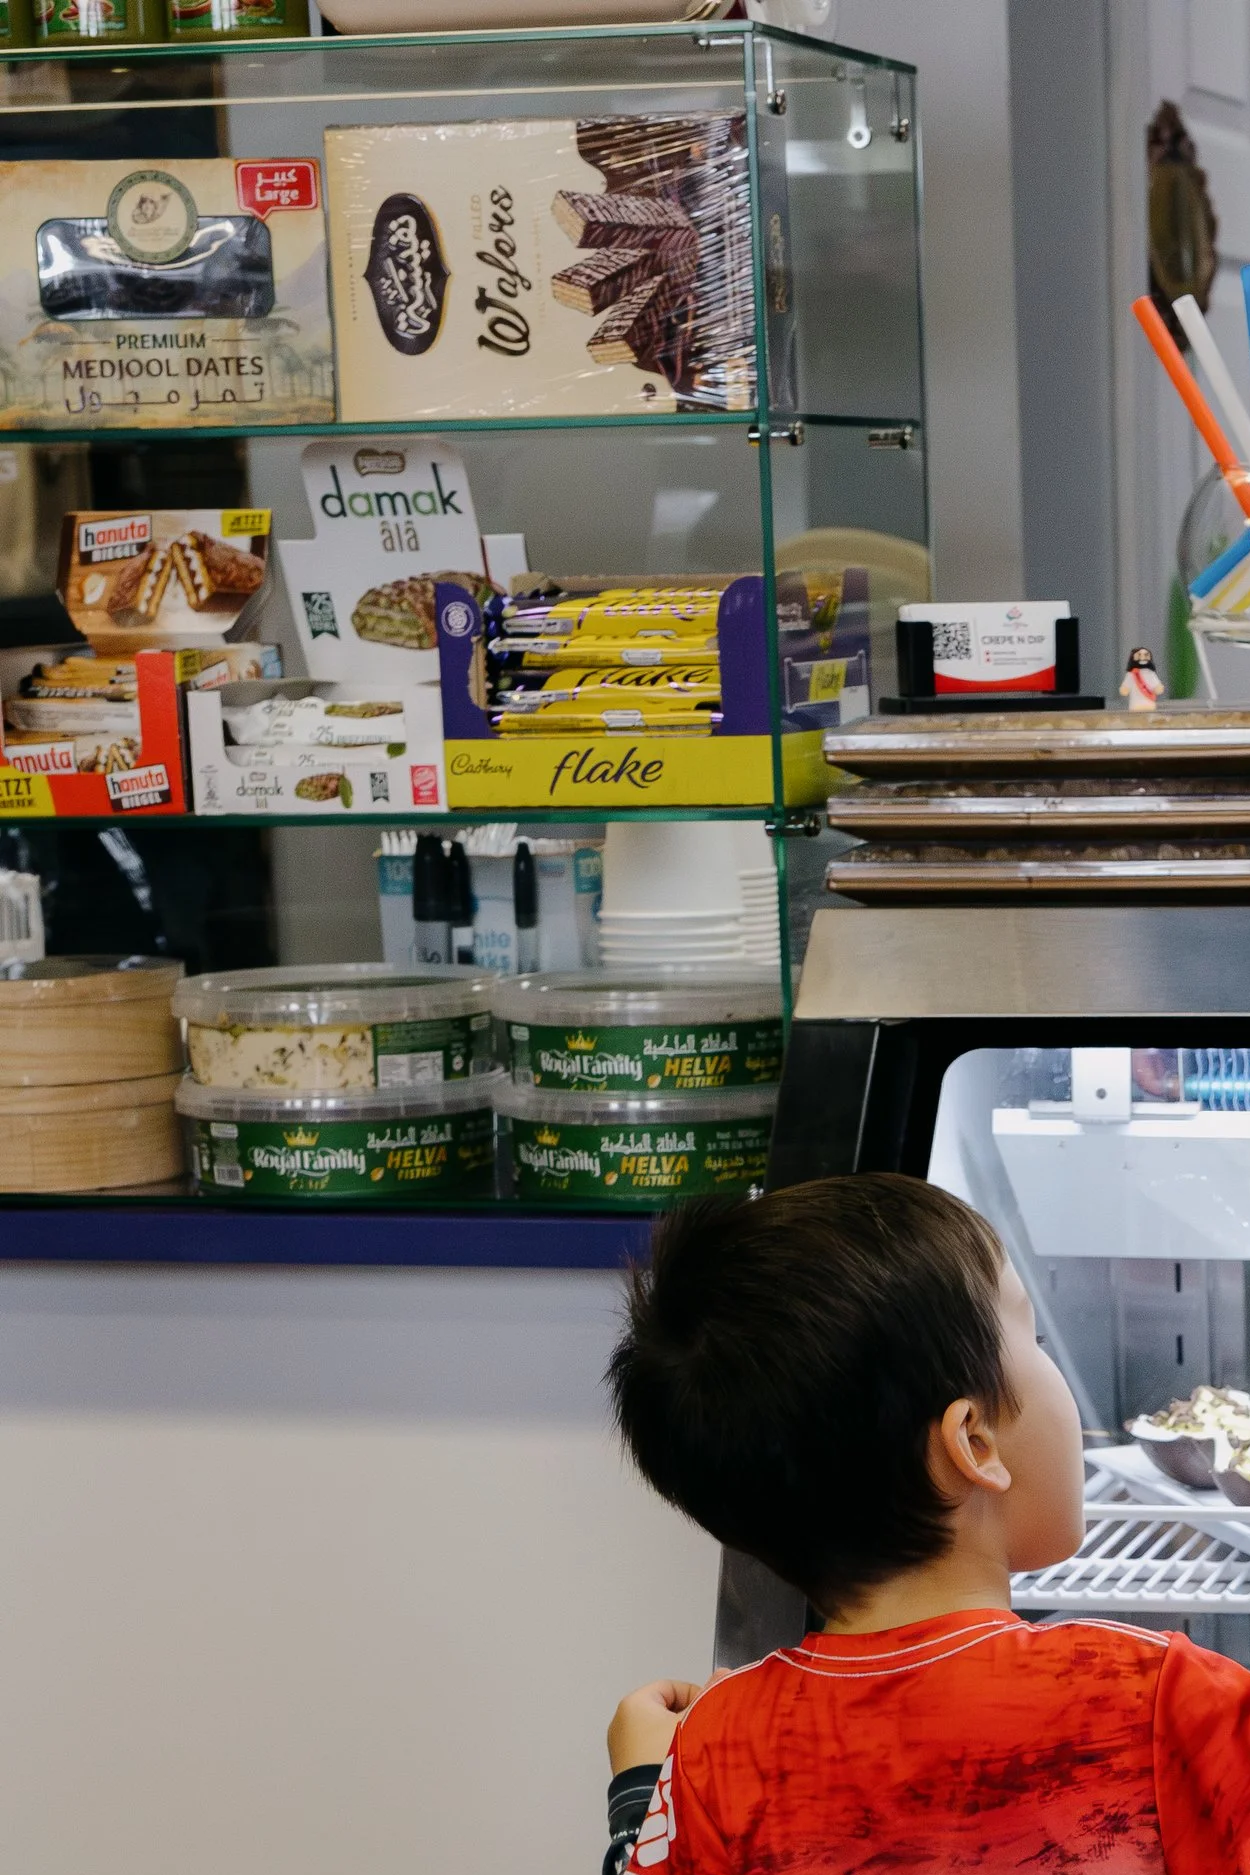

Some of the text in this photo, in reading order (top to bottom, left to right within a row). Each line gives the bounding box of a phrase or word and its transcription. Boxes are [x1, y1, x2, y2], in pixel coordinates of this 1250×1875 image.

[256, 168, 298, 187] كبير
[255, 189, 299, 205] Large
[475, 185, 532, 356] Wafers
[116, 333, 206, 349] PREMIUM
[63, 356, 264, 380] MEDJOOL DATES
[190, 382, 265, 411] تمر
[320, 462, 463, 518] damak
[84, 521, 148, 547] hanuta
[111, 769, 165, 795] hanuta
[450, 746, 663, 796] Cadbury flake
[540, 1050, 643, 1081] Royal Family
[664, 1055, 732, 1076] HELVA
[252, 1147, 366, 1177] Royal Family
[387, 1147, 448, 1169] HELVA
[550, 1148, 600, 1177] Family
[620, 1154, 689, 1176] HELVA
